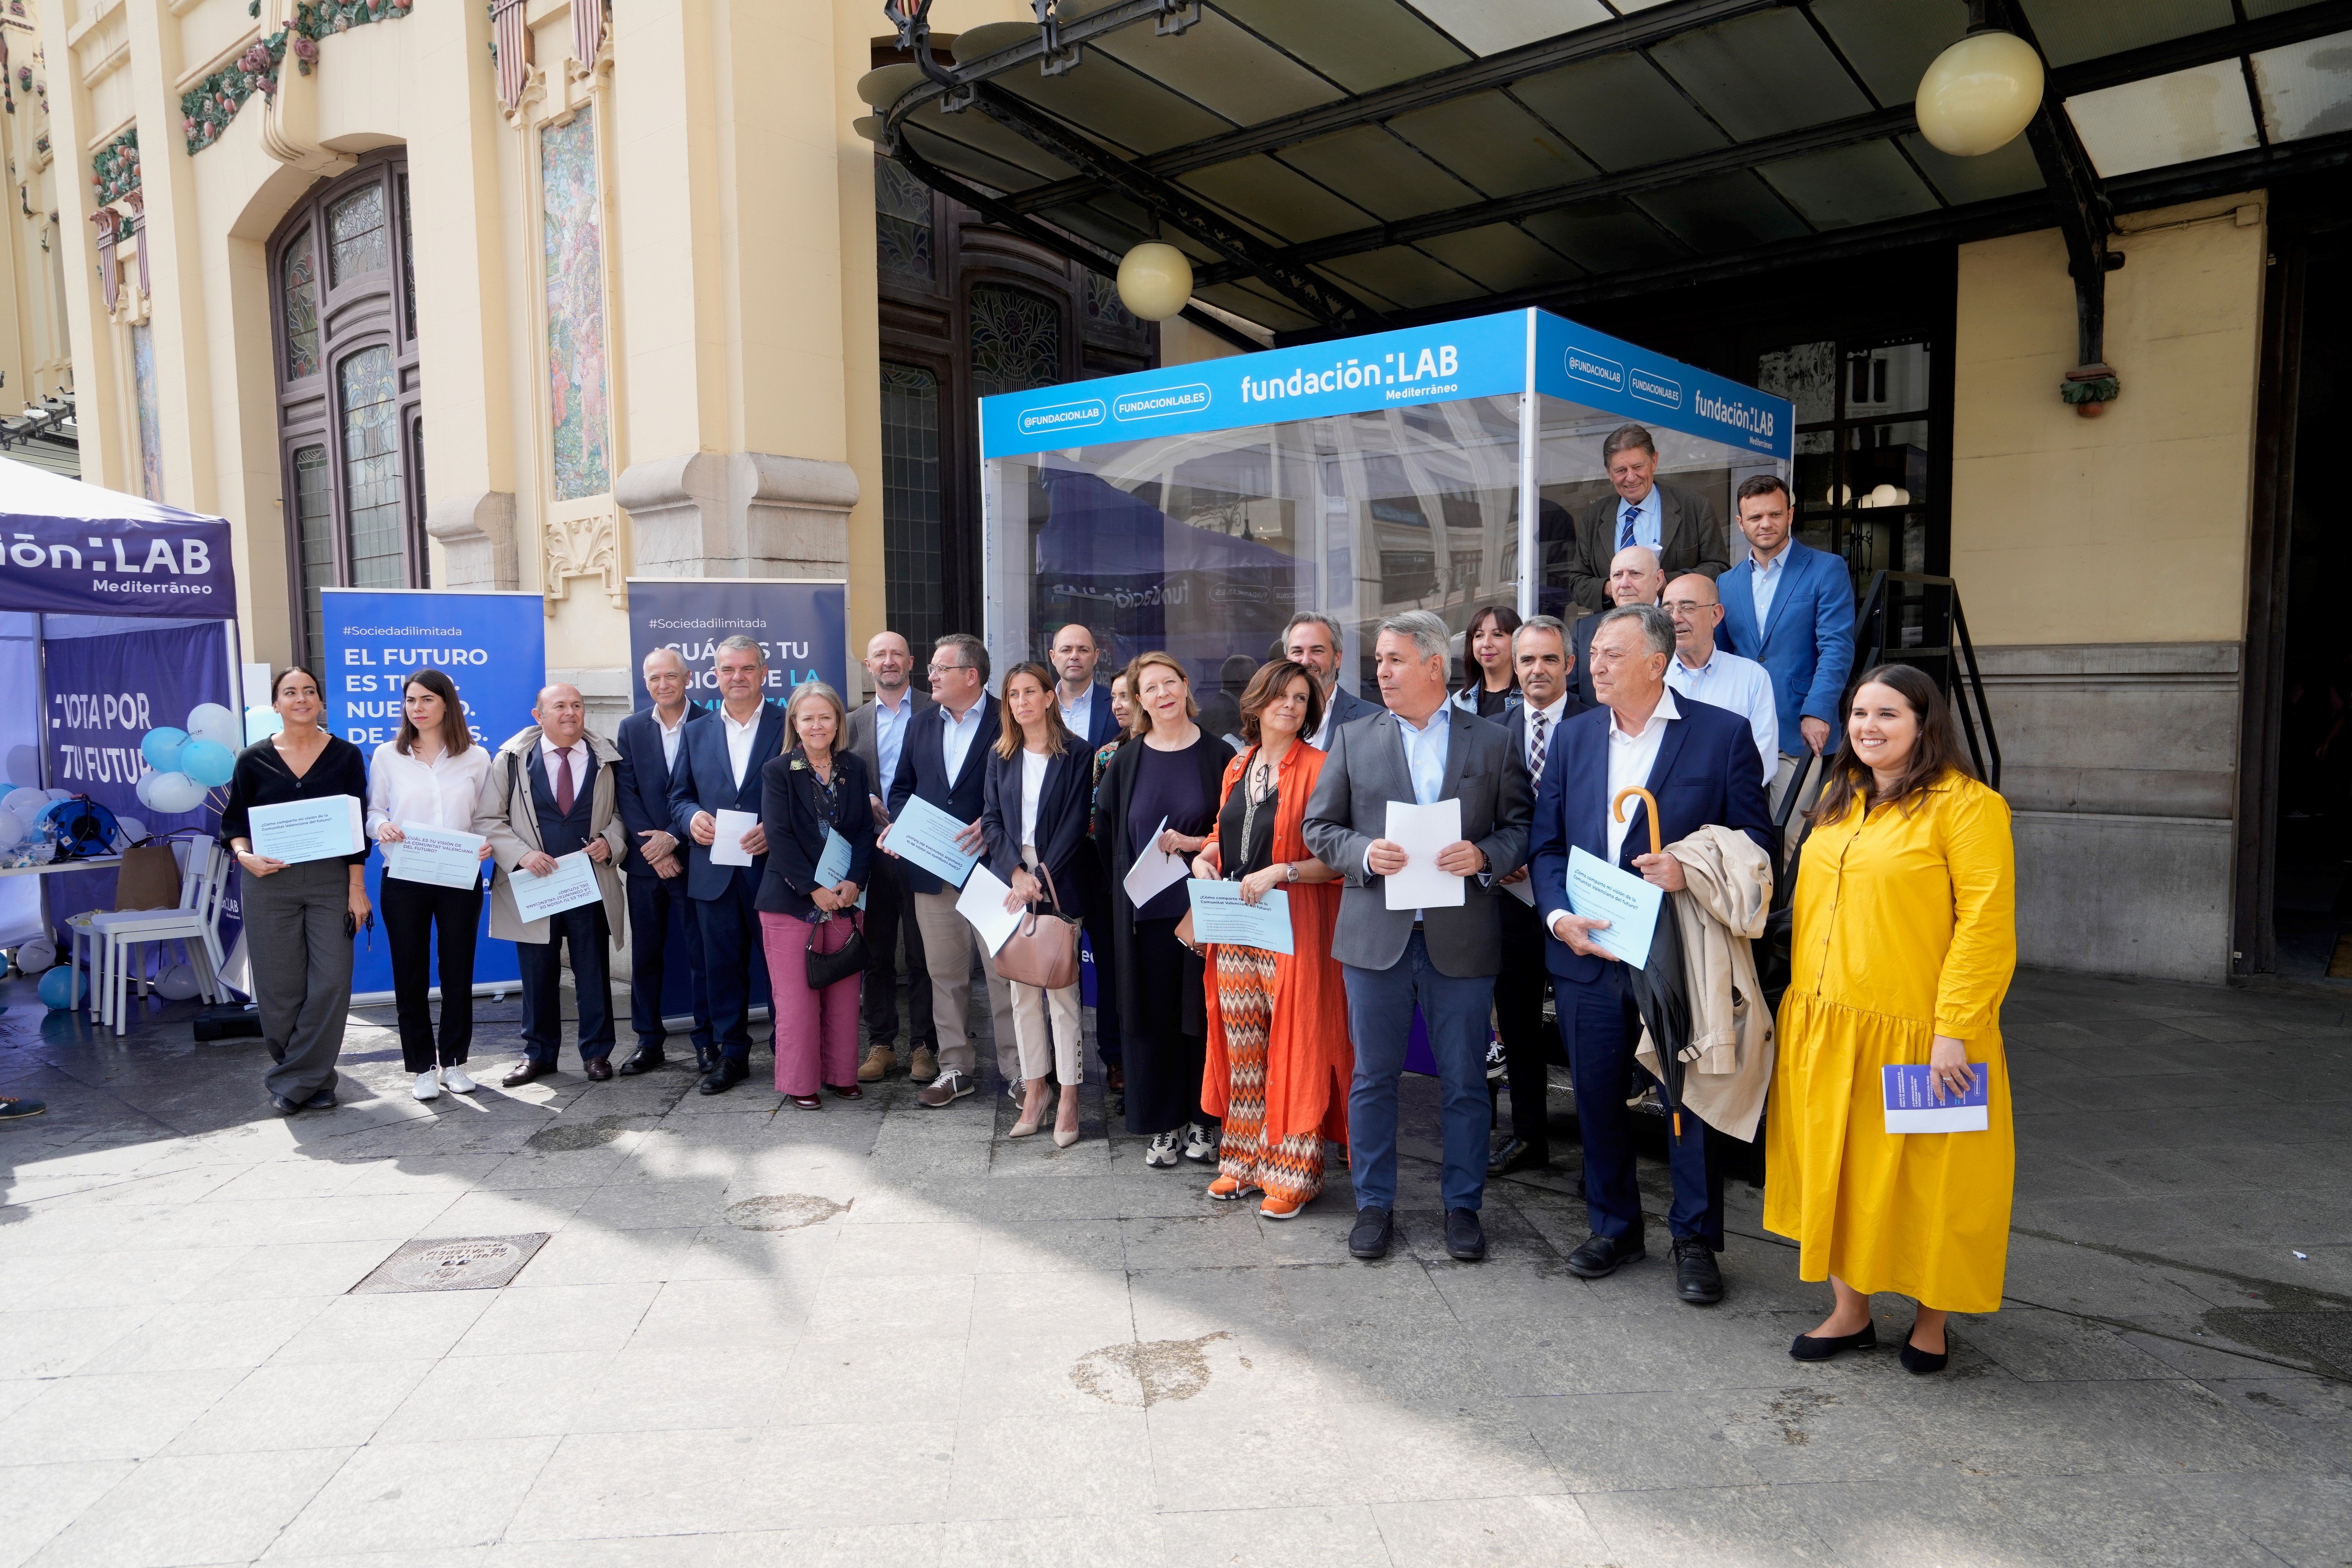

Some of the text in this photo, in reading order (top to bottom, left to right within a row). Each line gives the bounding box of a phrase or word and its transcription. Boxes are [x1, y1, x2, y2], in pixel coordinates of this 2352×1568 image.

[1569, 357, 1620, 383] @FUNDACION.LAB
[1632, 378, 1678, 401] FUNDACIONLAB.ES
[1119, 392, 1205, 413] FUNDACIONLAB.ES
[1024, 408, 1099, 428] @FUNDACION.LAB
[343, 626, 462, 636] #Sociedadilimitada
[649, 618, 767, 629] #Sociedadilimitada
[345, 648, 488, 665] EL FUTURO
[777, 642, 809, 659] TU
[346, 675, 378, 692] ES
[103, 693, 152, 730] POR
[348, 727, 384, 744] DE
[60, 744, 83, 780] TU
[906, 834, 919, 843] futuro?
[925, 845, 944, 857] Valenciana
[931, 853, 948, 864] comparto
[944, 855, 963, 867] Comunitat
[556, 889, 583, 900] COMUNITAT
[558, 886, 579, 895] FUTURO?
[1573, 874, 1591, 887] Comunitat
[1592, 884, 1614, 898] Valenciana
[1622, 899, 1638, 910] futuro?
[1586, 876, 1606, 887] comparto
[1613, 888, 1624, 897] visión
[526, 897, 555, 908] VALENCIANA
